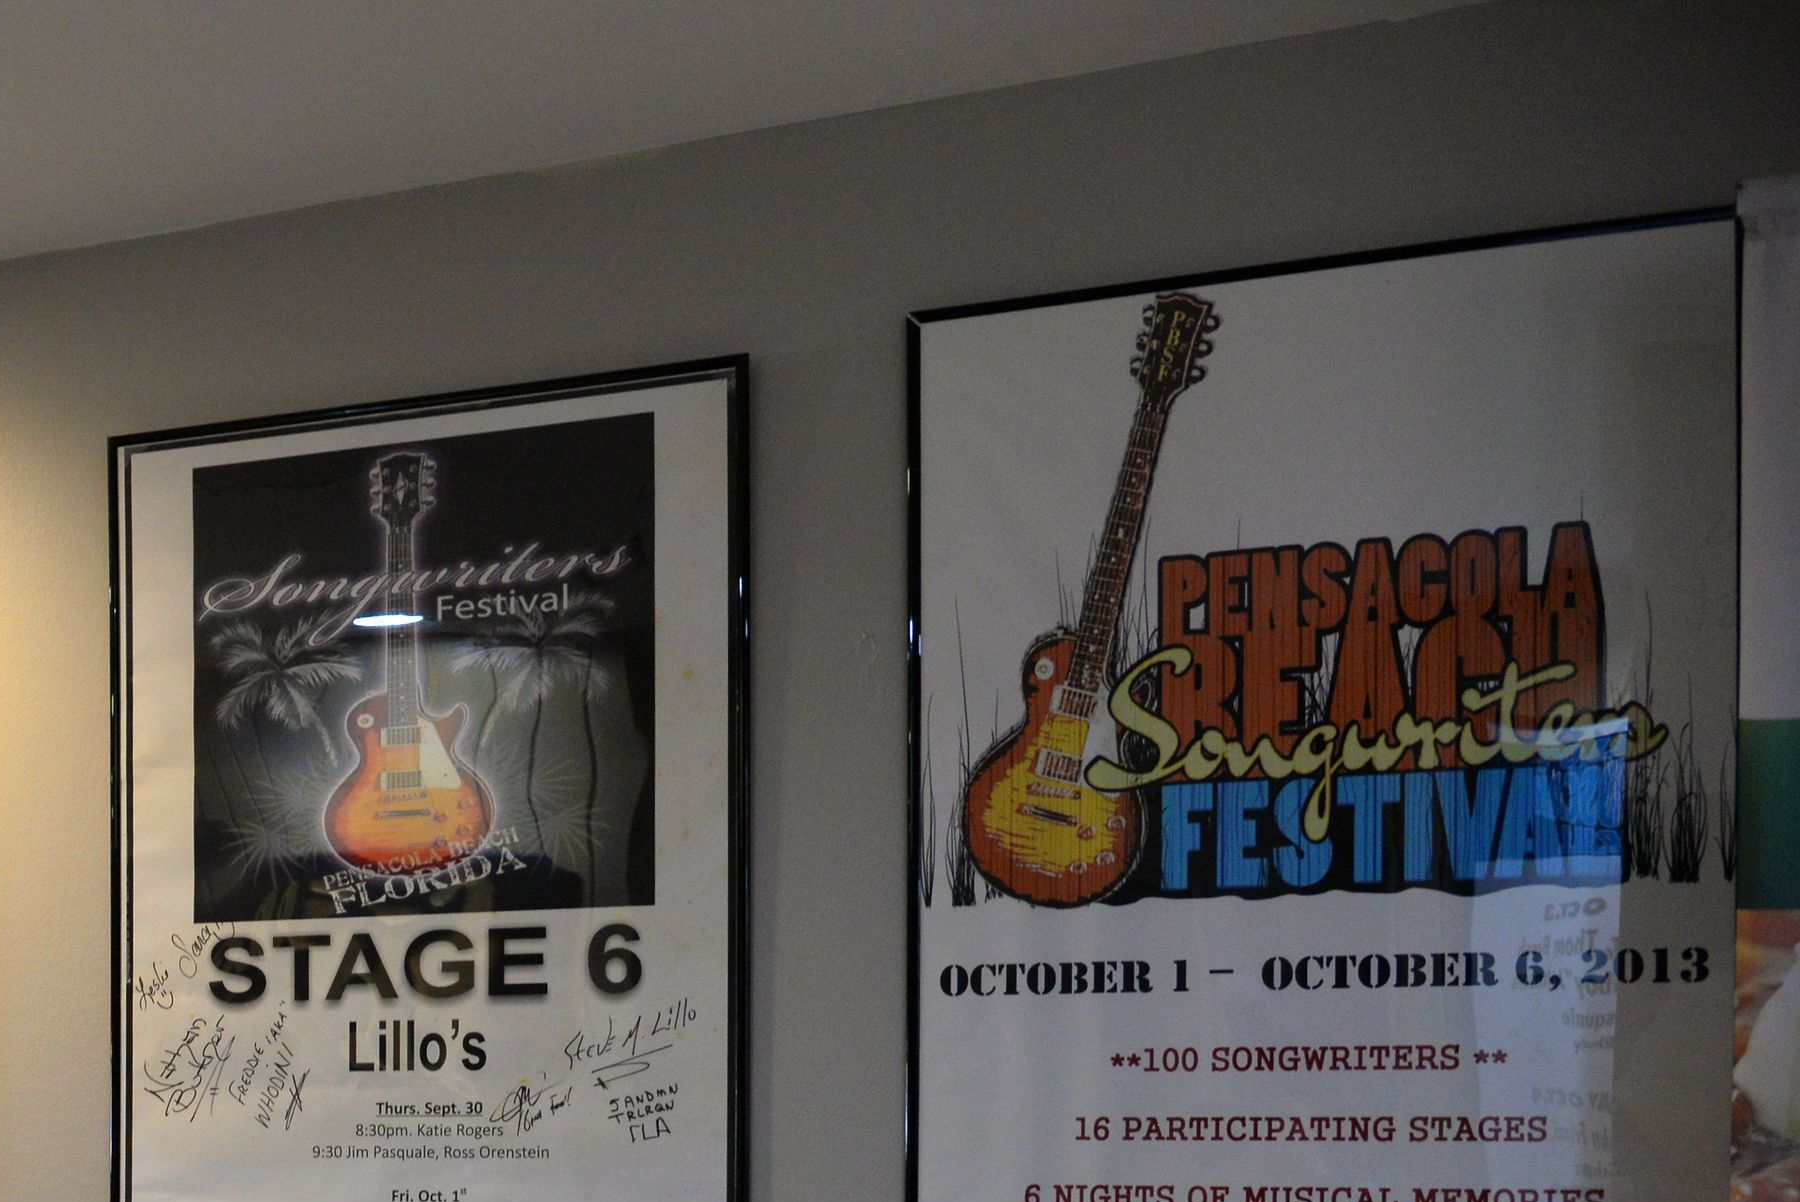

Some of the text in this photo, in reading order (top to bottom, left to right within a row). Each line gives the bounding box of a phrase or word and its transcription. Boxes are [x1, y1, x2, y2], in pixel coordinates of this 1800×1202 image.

[200, 541, 633, 647] Songwriters
[436, 584, 570, 622] Festival
[1157, 520, 1602, 636] PENSACOLA
[1157, 608, 1606, 780] BEACH
[1084, 643, 1669, 843] Songwriters
[1160, 763, 1628, 892] FESTIVAL
[322, 826, 520, 891] PENSACOLA BEACH
[329, 846, 528, 915] FLORIDA
[208, 926, 548, 1003] STAGE
[587, 923, 644, 996] 6
[939, 959, 1153, 997] OCTOBER
[1172, 958, 1189, 992] 1
[1260, 951, 1499, 991] OCTOBER
[1515, 949, 1561, 991] 6,
[1580, 946, 1709, 985] 2013
[347, 1019, 487, 1072] Lillo's
[1210, 1043, 1460, 1072] SONGWRITERS
[354, 1122, 504, 1140] 8:30pm. Katie Rogers
[375, 1100, 483, 1117] Thurs. Sept. 30
[1074, 1115, 1110, 1141] 16
[1121, 1115, 1397, 1142] PARTICIPATING
[1408, 1115, 1547, 1142] STAGES
[311, 1143, 549, 1162] 9:30 Jim Pasquale, Ross Orenstein
[391, 1188, 415, 1202] Fri.
[417, 1189, 448, 1202] Oct.
